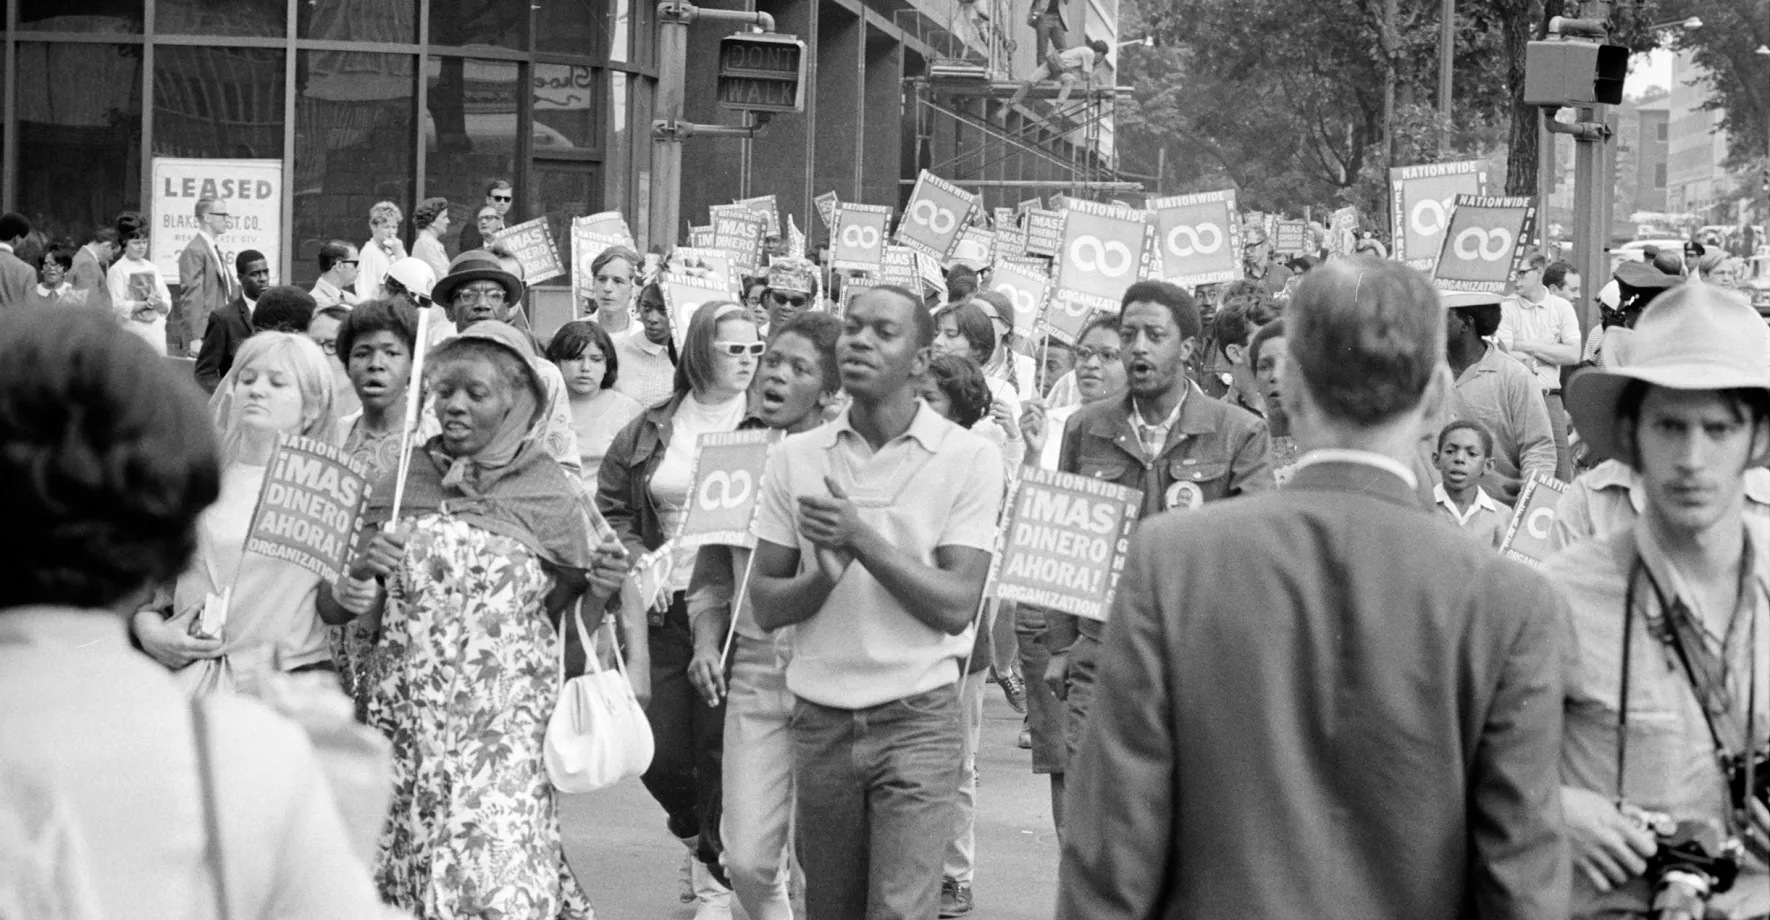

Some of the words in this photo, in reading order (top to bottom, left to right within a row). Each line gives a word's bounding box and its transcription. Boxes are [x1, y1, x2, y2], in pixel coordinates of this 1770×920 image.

[730, 45, 797, 71] DONT
[729, 80, 793, 104] WALK
[1402, 161, 1477, 179] NATIONWIDE
[164, 177, 272, 200] LEASED
[925, 172, 975, 203] NATIONWIDE
[1156, 192, 1225, 209] NATIONWIDE
[1459, 195, 1531, 208] NATIONWIDE
[163, 214, 200, 229] BLAKE
[718, 210, 761, 224] NATIONWIDE
[842, 203, 887, 214] NATIONWIDE
[1070, 199, 1147, 223] NATIONWIDE
[1393, 180, 1405, 262] WELFARE
[543, 223, 562, 268] RIGHTS
[715, 235, 755, 252] DINERO
[880, 213, 892, 265] RIGHTS
[946, 204, 977, 257] RIGHTS
[1226, 200, 1241, 269] RIGHTS
[1509, 207, 1536, 282] RIGHTS
[753, 223, 767, 271] RIGHTS
[902, 234, 944, 260] GANIZATION
[1139, 224, 1155, 277] RIGH
[667, 272, 729, 292] NATIONWIDE
[997, 259, 1047, 285] NATIONWIDE
[1434, 278, 1506, 292] ORGANIZATION
[1057, 288, 1122, 313] ORGANIZATI
[702, 429, 768, 446] NATIONWIDE
[280, 432, 369, 479] NATIONWIDE
[274, 452, 359, 508] ¡MAS
[1023, 466, 1128, 501] NATIONWIDE
[1540, 473, 1571, 493] NATIO
[266, 482, 350, 534] DINERO
[1021, 487, 1116, 534] ¡MAS
[258, 511, 344, 563] AHORA!
[341, 483, 373, 578] RIGHTS
[1014, 522, 1108, 563] DINERO
[249, 538, 340, 585] ORGANIZATION
[1106, 503, 1137, 604] RIGHTS
[1506, 549, 1539, 570] ORGANI
[1007, 552, 1102, 594] AHORA!
[996, 583, 1102, 617] ORGANIZATION
